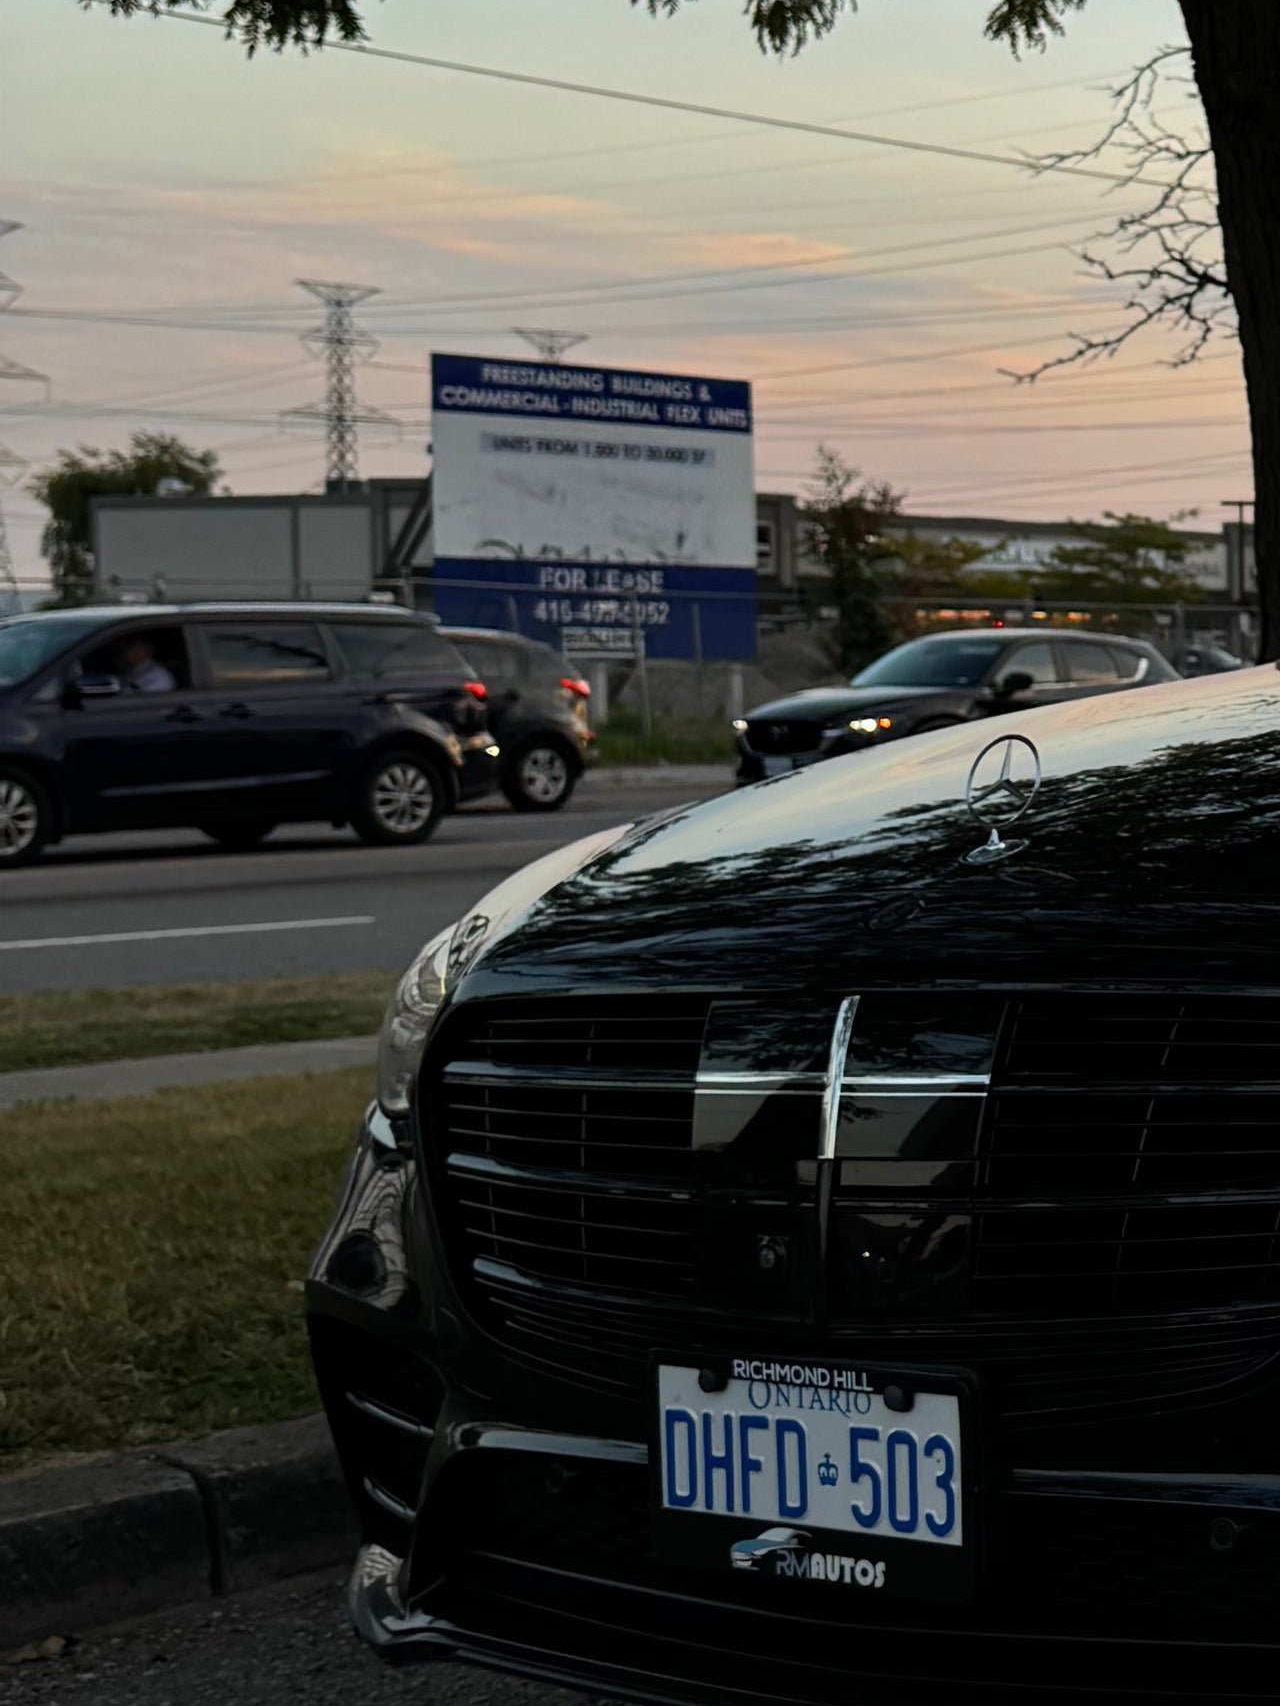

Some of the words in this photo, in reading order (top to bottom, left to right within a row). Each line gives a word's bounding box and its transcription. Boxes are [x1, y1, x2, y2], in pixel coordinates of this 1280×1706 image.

[482, 363, 605, 392] FREESTANDING
[612, 374, 693, 400] BUILDINGS
[440, 384, 560, 413] COMMERCIAL
[572, 395, 660, 422] INDUSTRIAL
[665, 403, 702, 423] FLEX
[707, 407, 748, 428] UNITS
[536, 438, 577, 456] FROM
[540, 567, 587, 591] FOR
[733, 1359, 830, 1388] RICHMOND
[833, 1370, 874, 1392] HILL
[748, 1381, 872, 1418] ONTARIO
[665, 1408, 808, 1519] DHFD
[849, 1425, 956, 1537] 503
